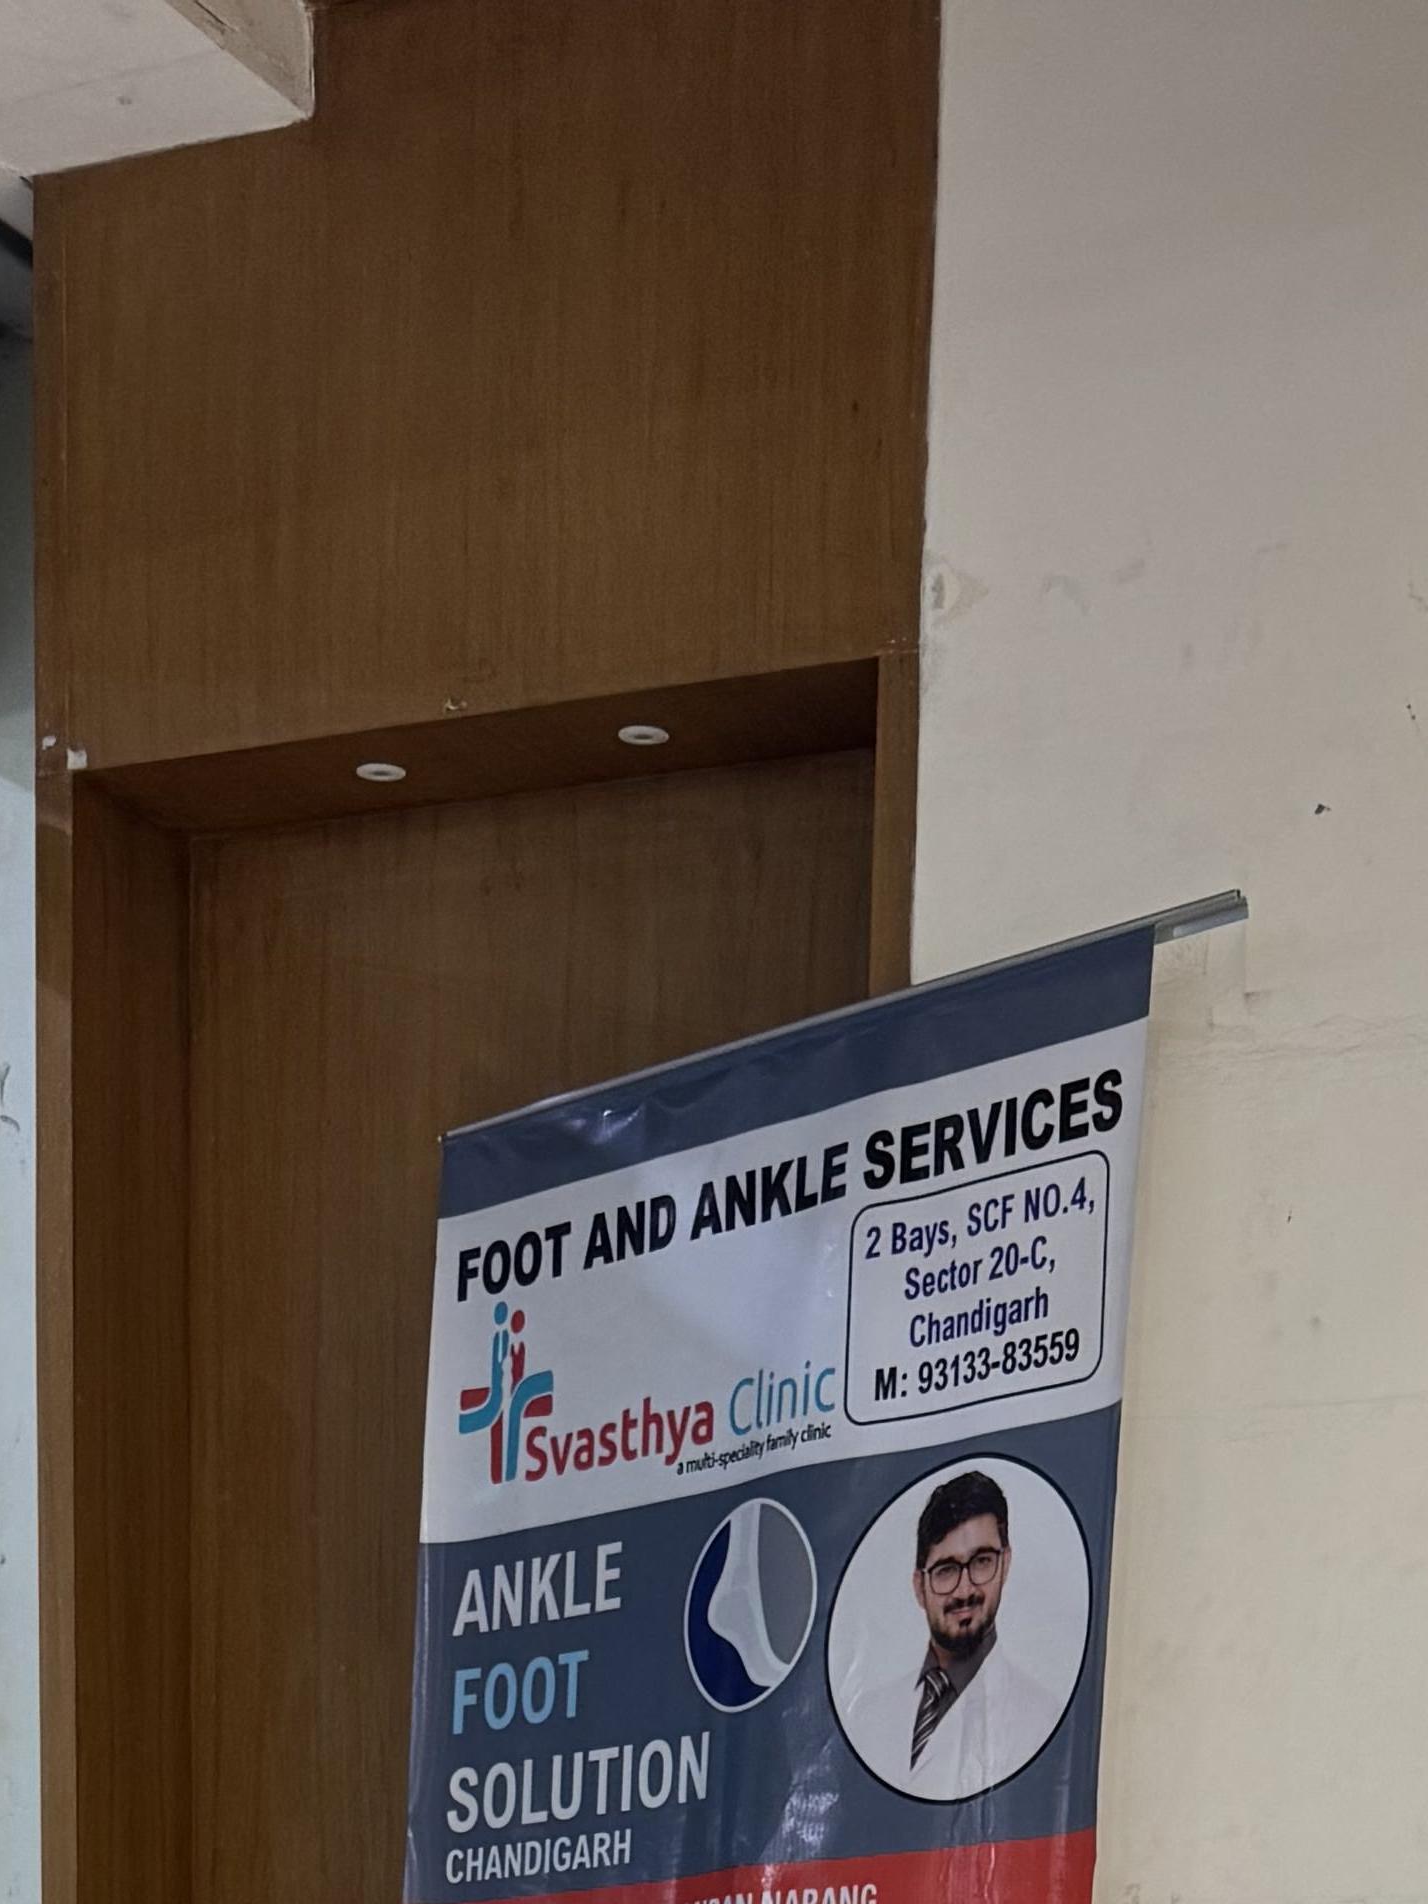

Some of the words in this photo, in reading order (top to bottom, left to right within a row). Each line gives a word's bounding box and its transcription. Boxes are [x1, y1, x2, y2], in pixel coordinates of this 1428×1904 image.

[457, 1221, 572, 1302] FOOT
[583, 1194, 677, 1271] AND
[689, 1142, 850, 1241] ANKLE
[863, 1068, 1123, 1190] SERVICES
[865, 1226, 881, 1260] 2
[891, 1220, 957, 1258] Bays,
[967, 1194, 1015, 1237] SCF
[1024, 1176, 1095, 1223] NO.4,
[904, 1259, 983, 1300] Sector
[989, 1235, 1056, 1281] 20-C,
[909, 1286, 1049, 1348] Chandigarh
[874, 1366, 908, 1401] M:
[918, 1328, 1080, 1394] 93133-83559
[525, 1396, 714, 1482] Svasthya
[729, 1360, 836, 1436] Clinic
[676, 1462, 684, 1475] a
[686, 1438, 765, 1473] multi-speciality
[766, 1428, 798, 1451] family
[801, 1422, 832, 1443] clinic
[452, 1541, 622, 1636] ANKLE
[452, 1650, 589, 1735] FOOT
[446, 1731, 710, 1833] SOLUTION
[446, 1828, 632, 1884] CHANDIGARH
